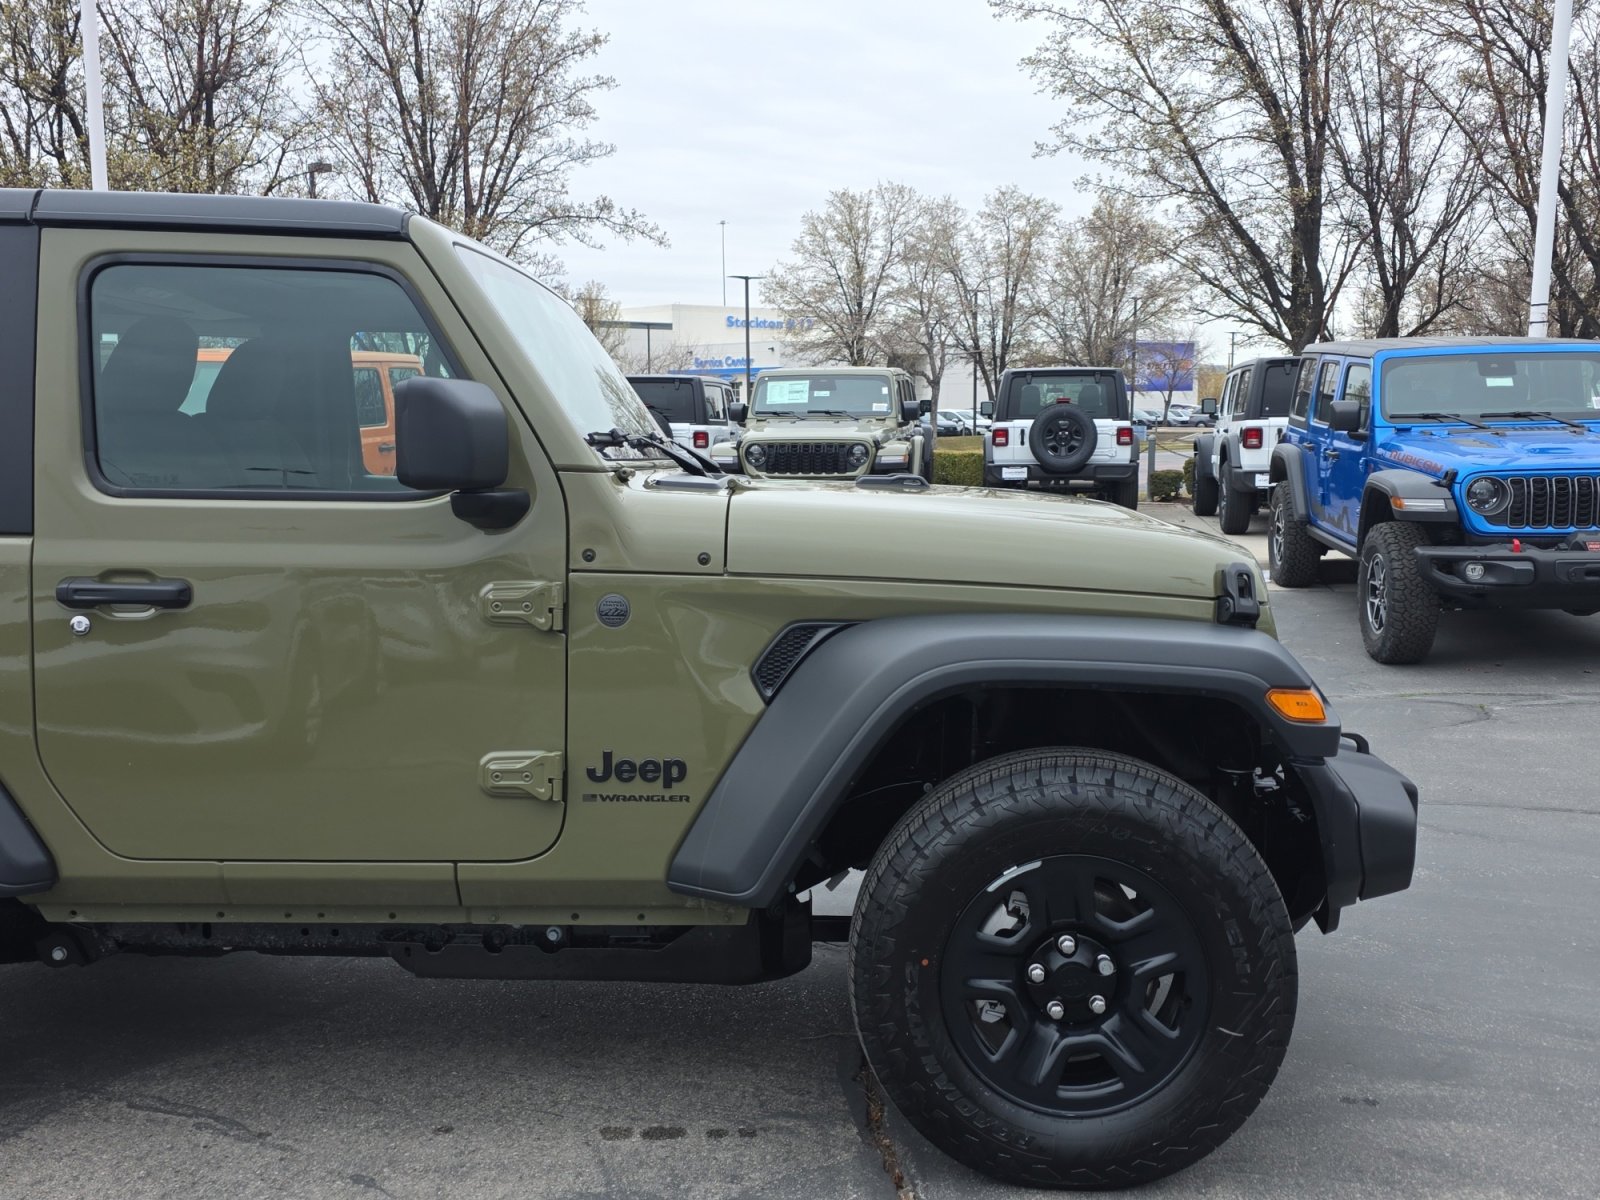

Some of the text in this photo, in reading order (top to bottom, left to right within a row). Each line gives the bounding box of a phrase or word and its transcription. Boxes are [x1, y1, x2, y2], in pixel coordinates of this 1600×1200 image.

[1390, 450, 1444, 472] RUBICON
[586, 750, 687, 789] Jeep
[599, 793, 690, 803] WRANGLER
